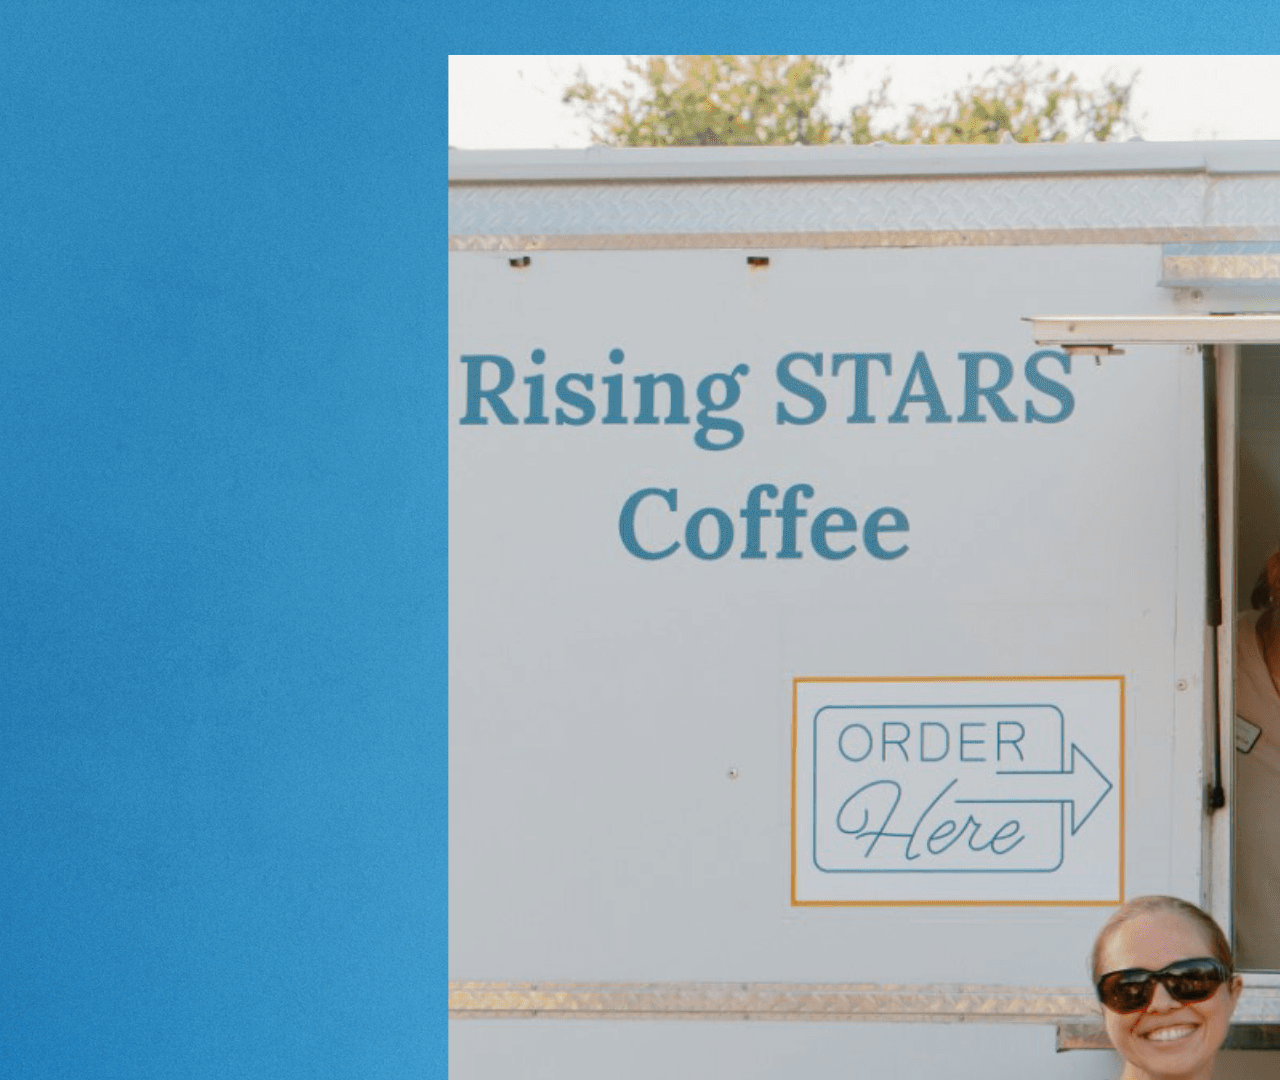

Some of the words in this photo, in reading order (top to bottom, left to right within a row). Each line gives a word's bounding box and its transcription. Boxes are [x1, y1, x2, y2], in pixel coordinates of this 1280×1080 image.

[459, 348, 749, 451] Rising
[776, 350, 1076, 426] STARS
[618, 483, 910, 561] Coffee
[838, 722, 1026, 763] ORDER
[836, 778, 1025, 860] Here
